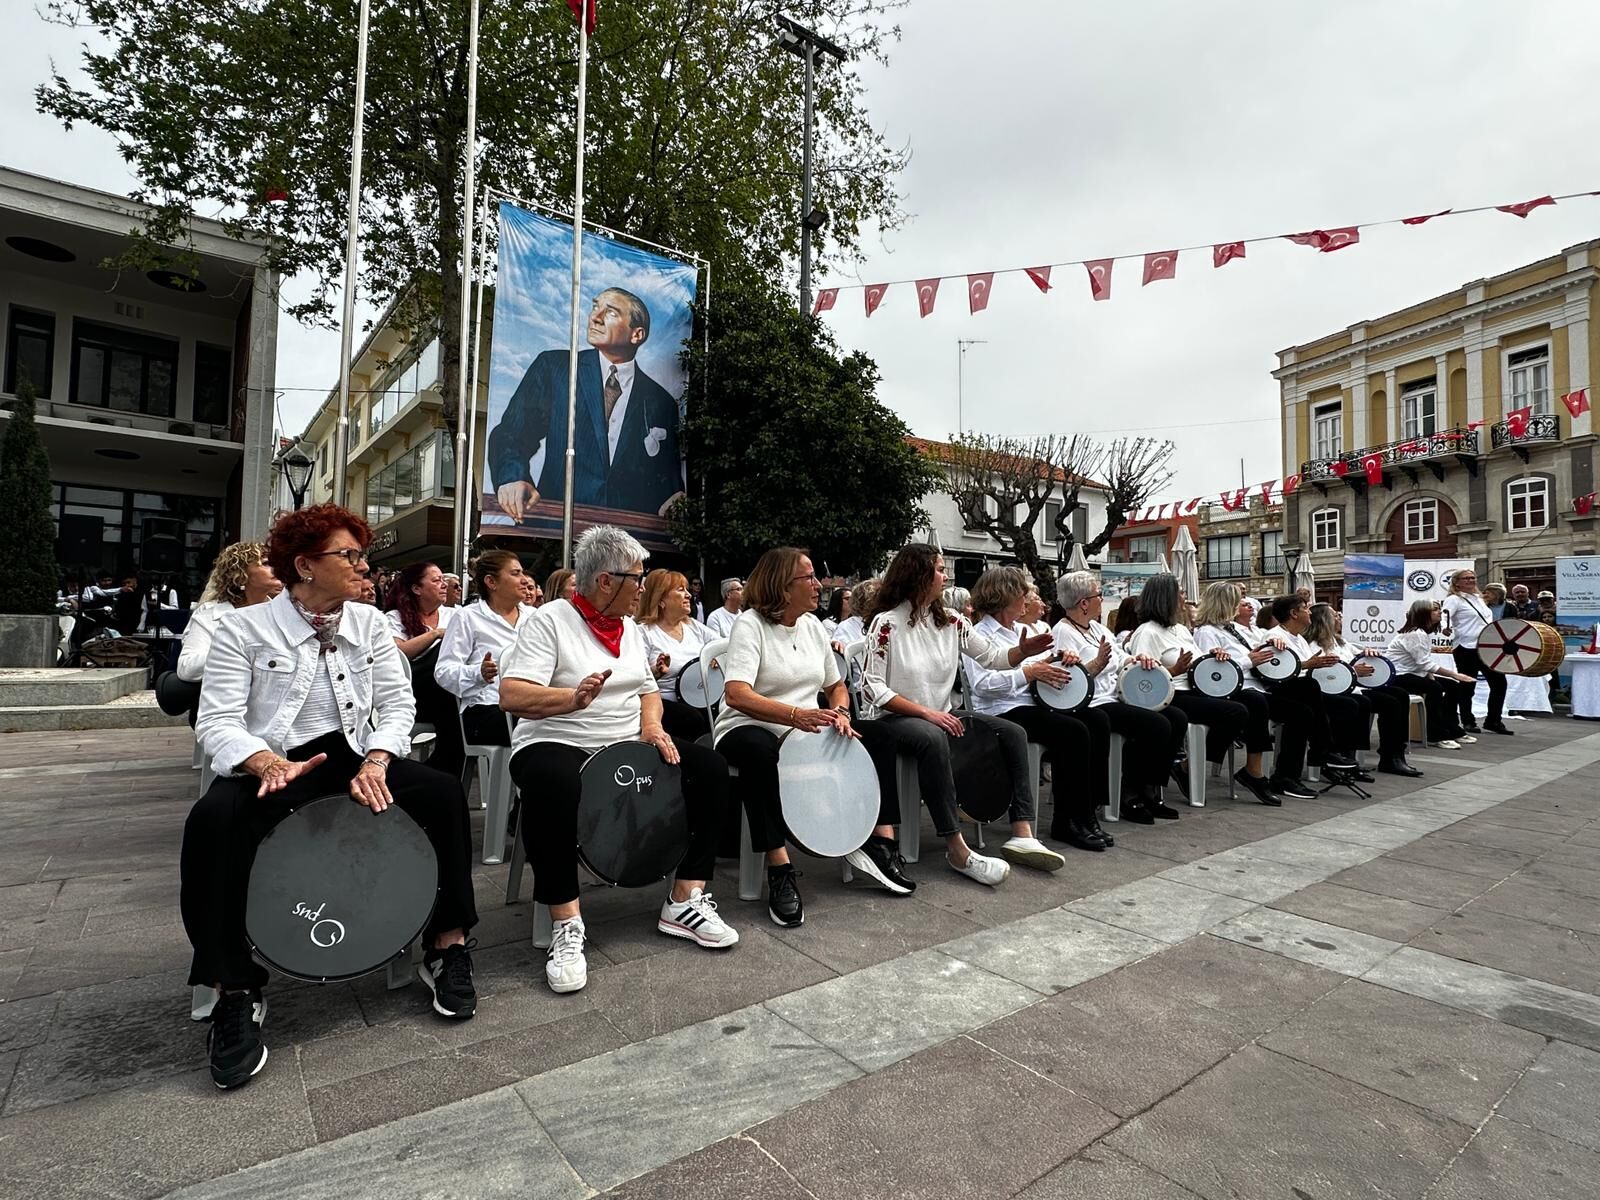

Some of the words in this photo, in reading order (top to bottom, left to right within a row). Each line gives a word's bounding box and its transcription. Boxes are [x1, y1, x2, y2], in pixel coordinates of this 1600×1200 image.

[1573, 562, 1589, 571] VS
[1350, 619, 1395, 634] COCOS
[1431, 637, 1453, 647] RİZM
[614, 765, 653, 793] Opus
[291, 901, 346, 948] Opus
